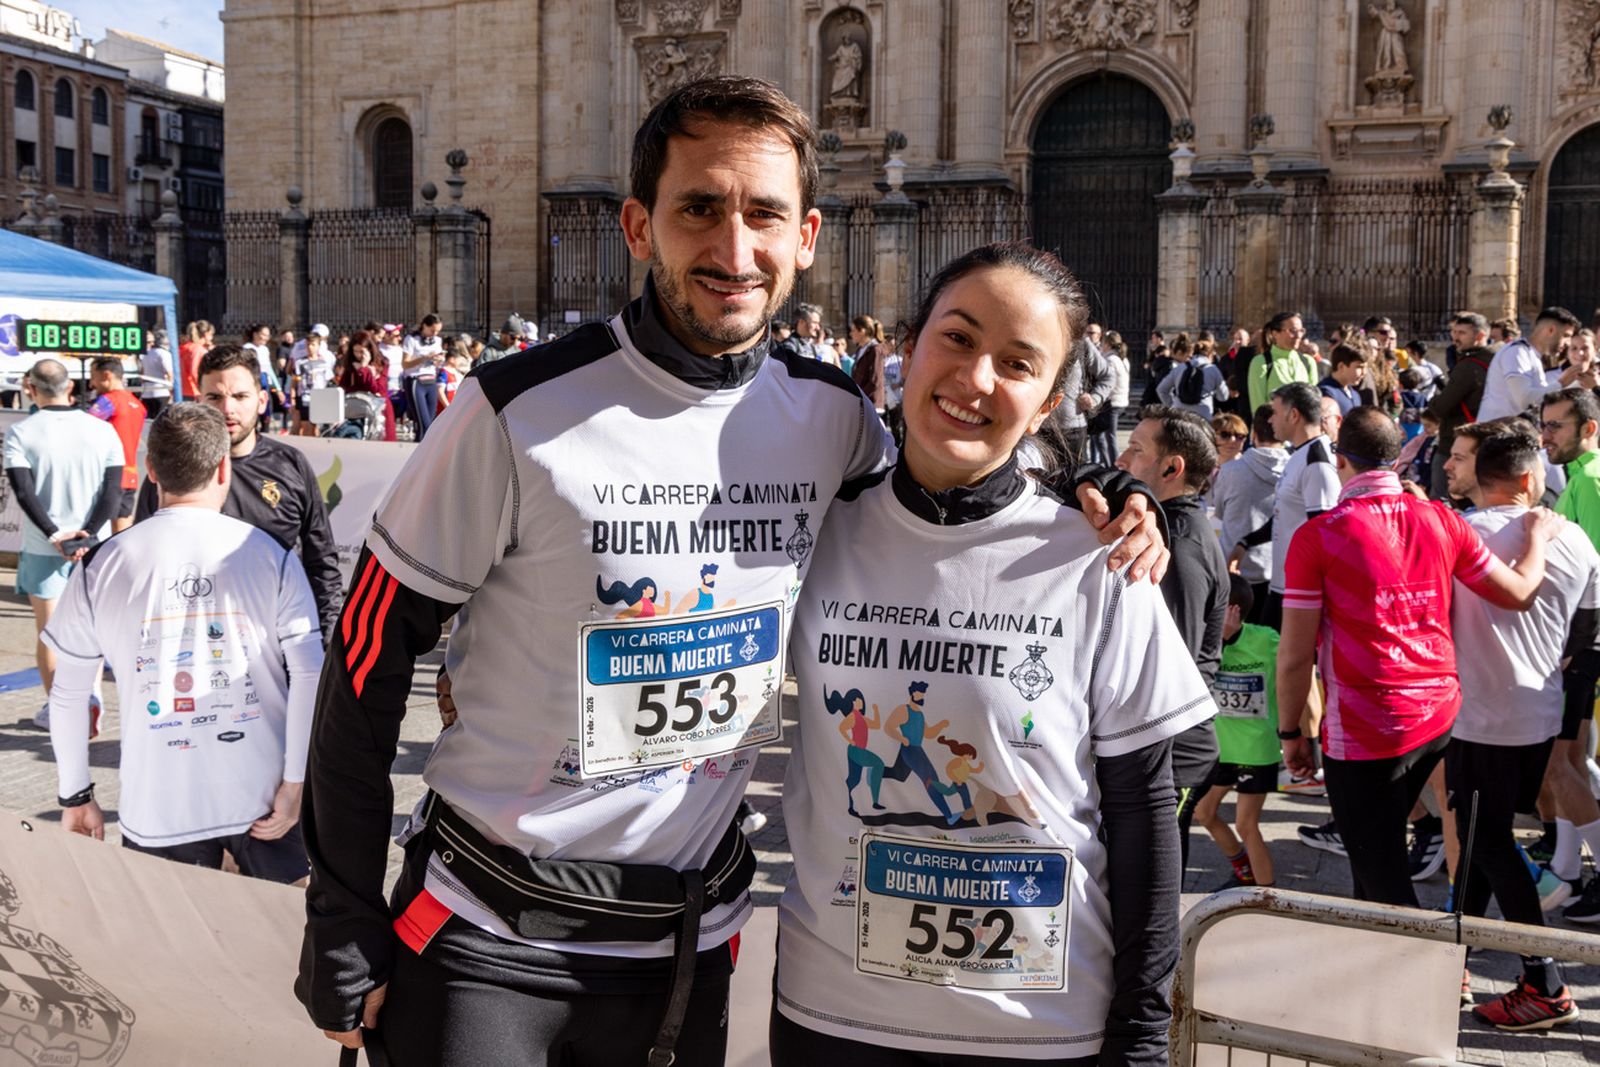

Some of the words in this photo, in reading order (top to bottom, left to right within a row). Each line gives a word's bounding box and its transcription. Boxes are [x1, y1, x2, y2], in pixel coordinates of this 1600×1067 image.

[592, 483, 614, 505] VI
[621, 482, 722, 505] CARRERA
[728, 481, 817, 504] CAMINATA
[591, 520, 680, 555] BUENA
[689, 518, 783, 554] MUERTE
[611, 635, 625, 648] VI
[629, 628, 694, 648] CARRERA
[697, 616, 762, 640] CAMINATA
[821, 600, 839, 620] VI
[843, 602, 940, 628] CARRERA
[949, 610, 1064, 638] CAMINATA
[609, 653, 667, 678] BUENA
[671, 643, 733, 673] MUERTE
[818, 633, 888, 669] BUENA
[898, 639, 1008, 678] MUERTE
[634, 672, 738, 737] 553
[1220, 691, 1252, 709] 337
[642, 735, 678, 746] ÁLVARO
[679, 730, 704, 742] COBO
[706, 724, 732, 737] TORRES
[888, 849, 900, 863] VI
[903, 851, 968, 871] CARRERA
[972, 858, 1044, 872] CAMINATA
[886, 869, 937, 896] BUENA
[943, 877, 1010, 901] MUERTE
[906, 903, 1014, 960] 552
[905, 953, 933, 966] ALICIA
[935, 958, 979, 970] ALMAGRO
[982, 959, 1015, 970] GARCÍA
